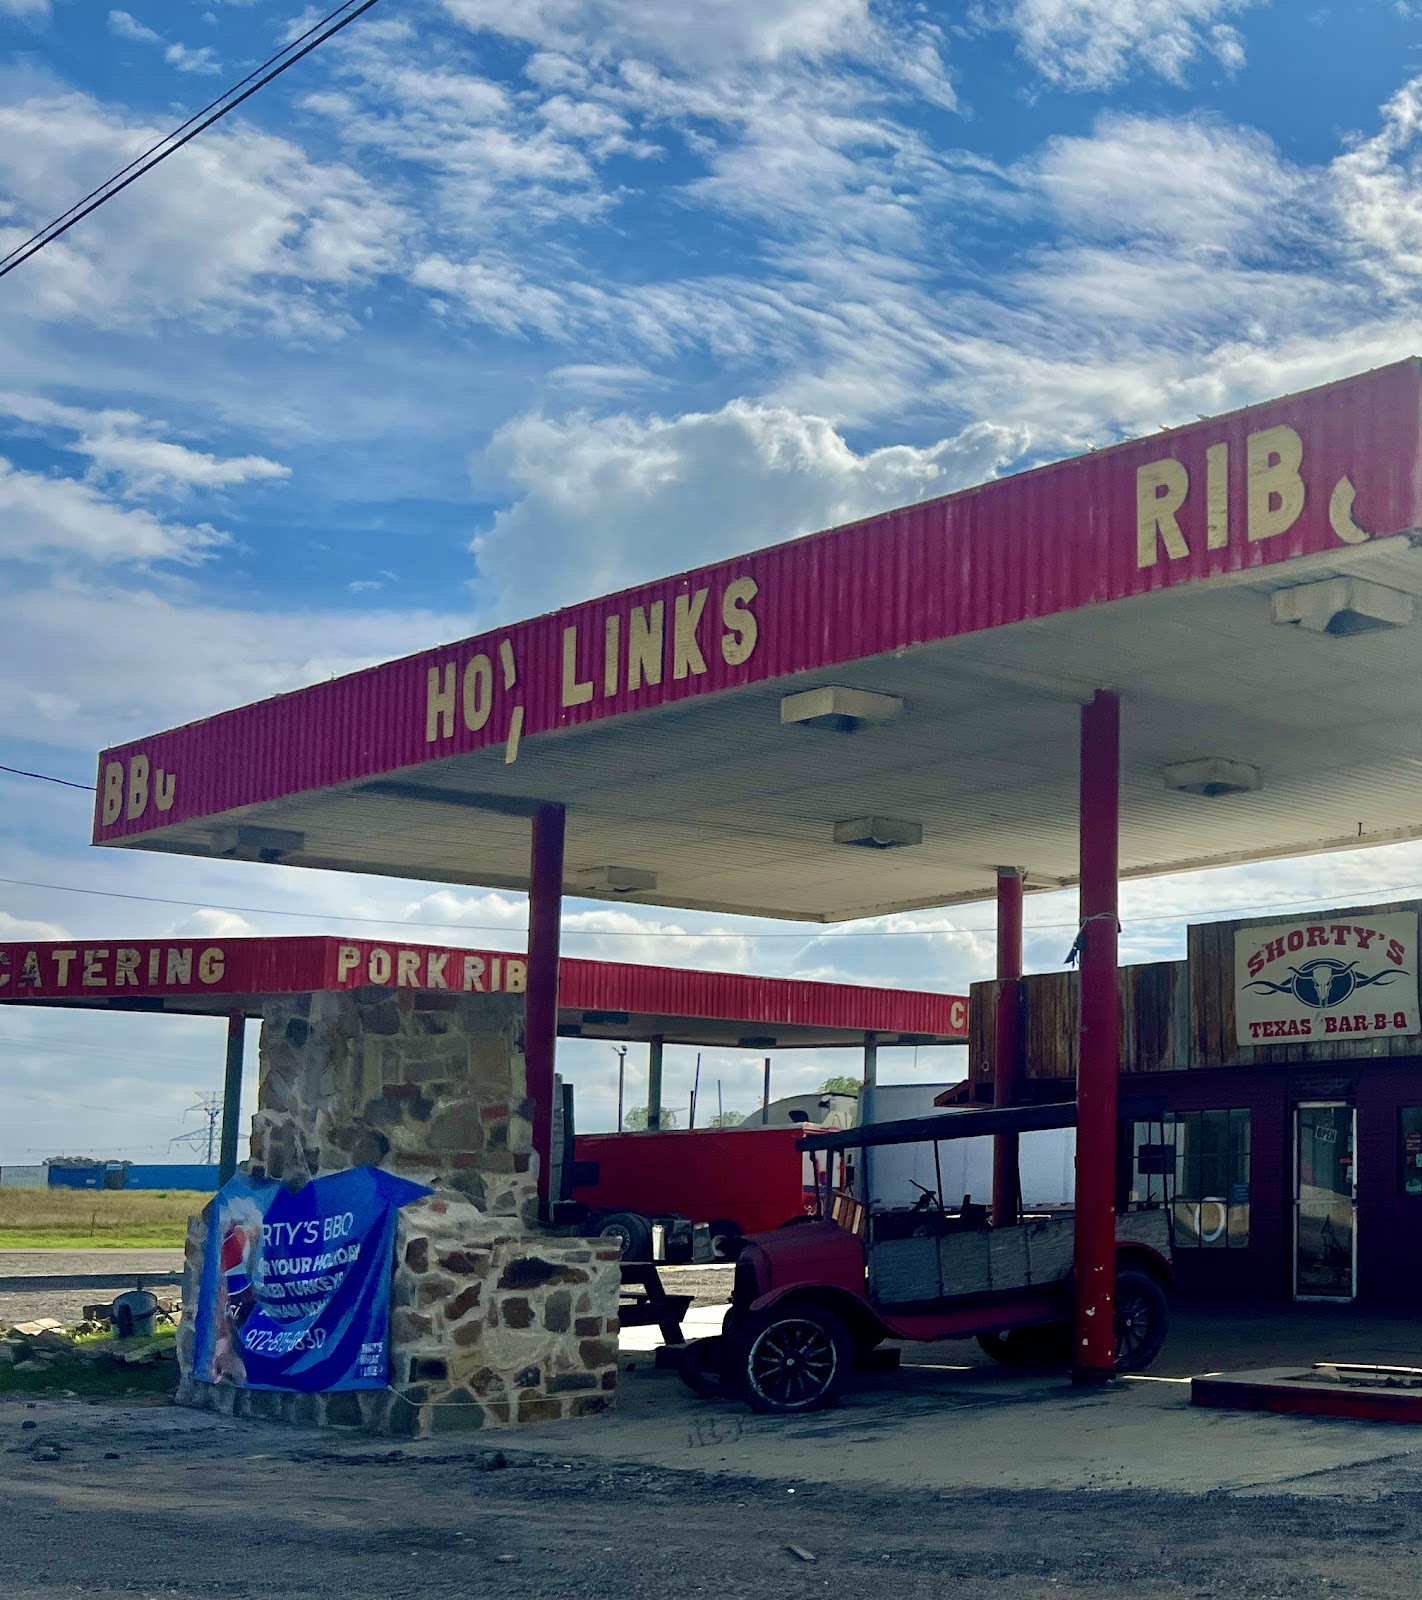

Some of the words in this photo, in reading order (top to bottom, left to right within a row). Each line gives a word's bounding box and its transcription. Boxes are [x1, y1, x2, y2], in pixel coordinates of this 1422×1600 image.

[562, 575, 758, 708] LINKS
[1247, 925, 1405, 978] SHORTY'S
[337, 946, 448, 988] PORK
[1249, 1018, 1311, 1038] TEXAS
[1325, 1012, 1407, 1033] BAR-B-Q
[1316, 1127, 1337, 1142] OPEN
[262, 1220, 319, 1247] RTY'S
[273, 1257, 311, 1276] YOUR
